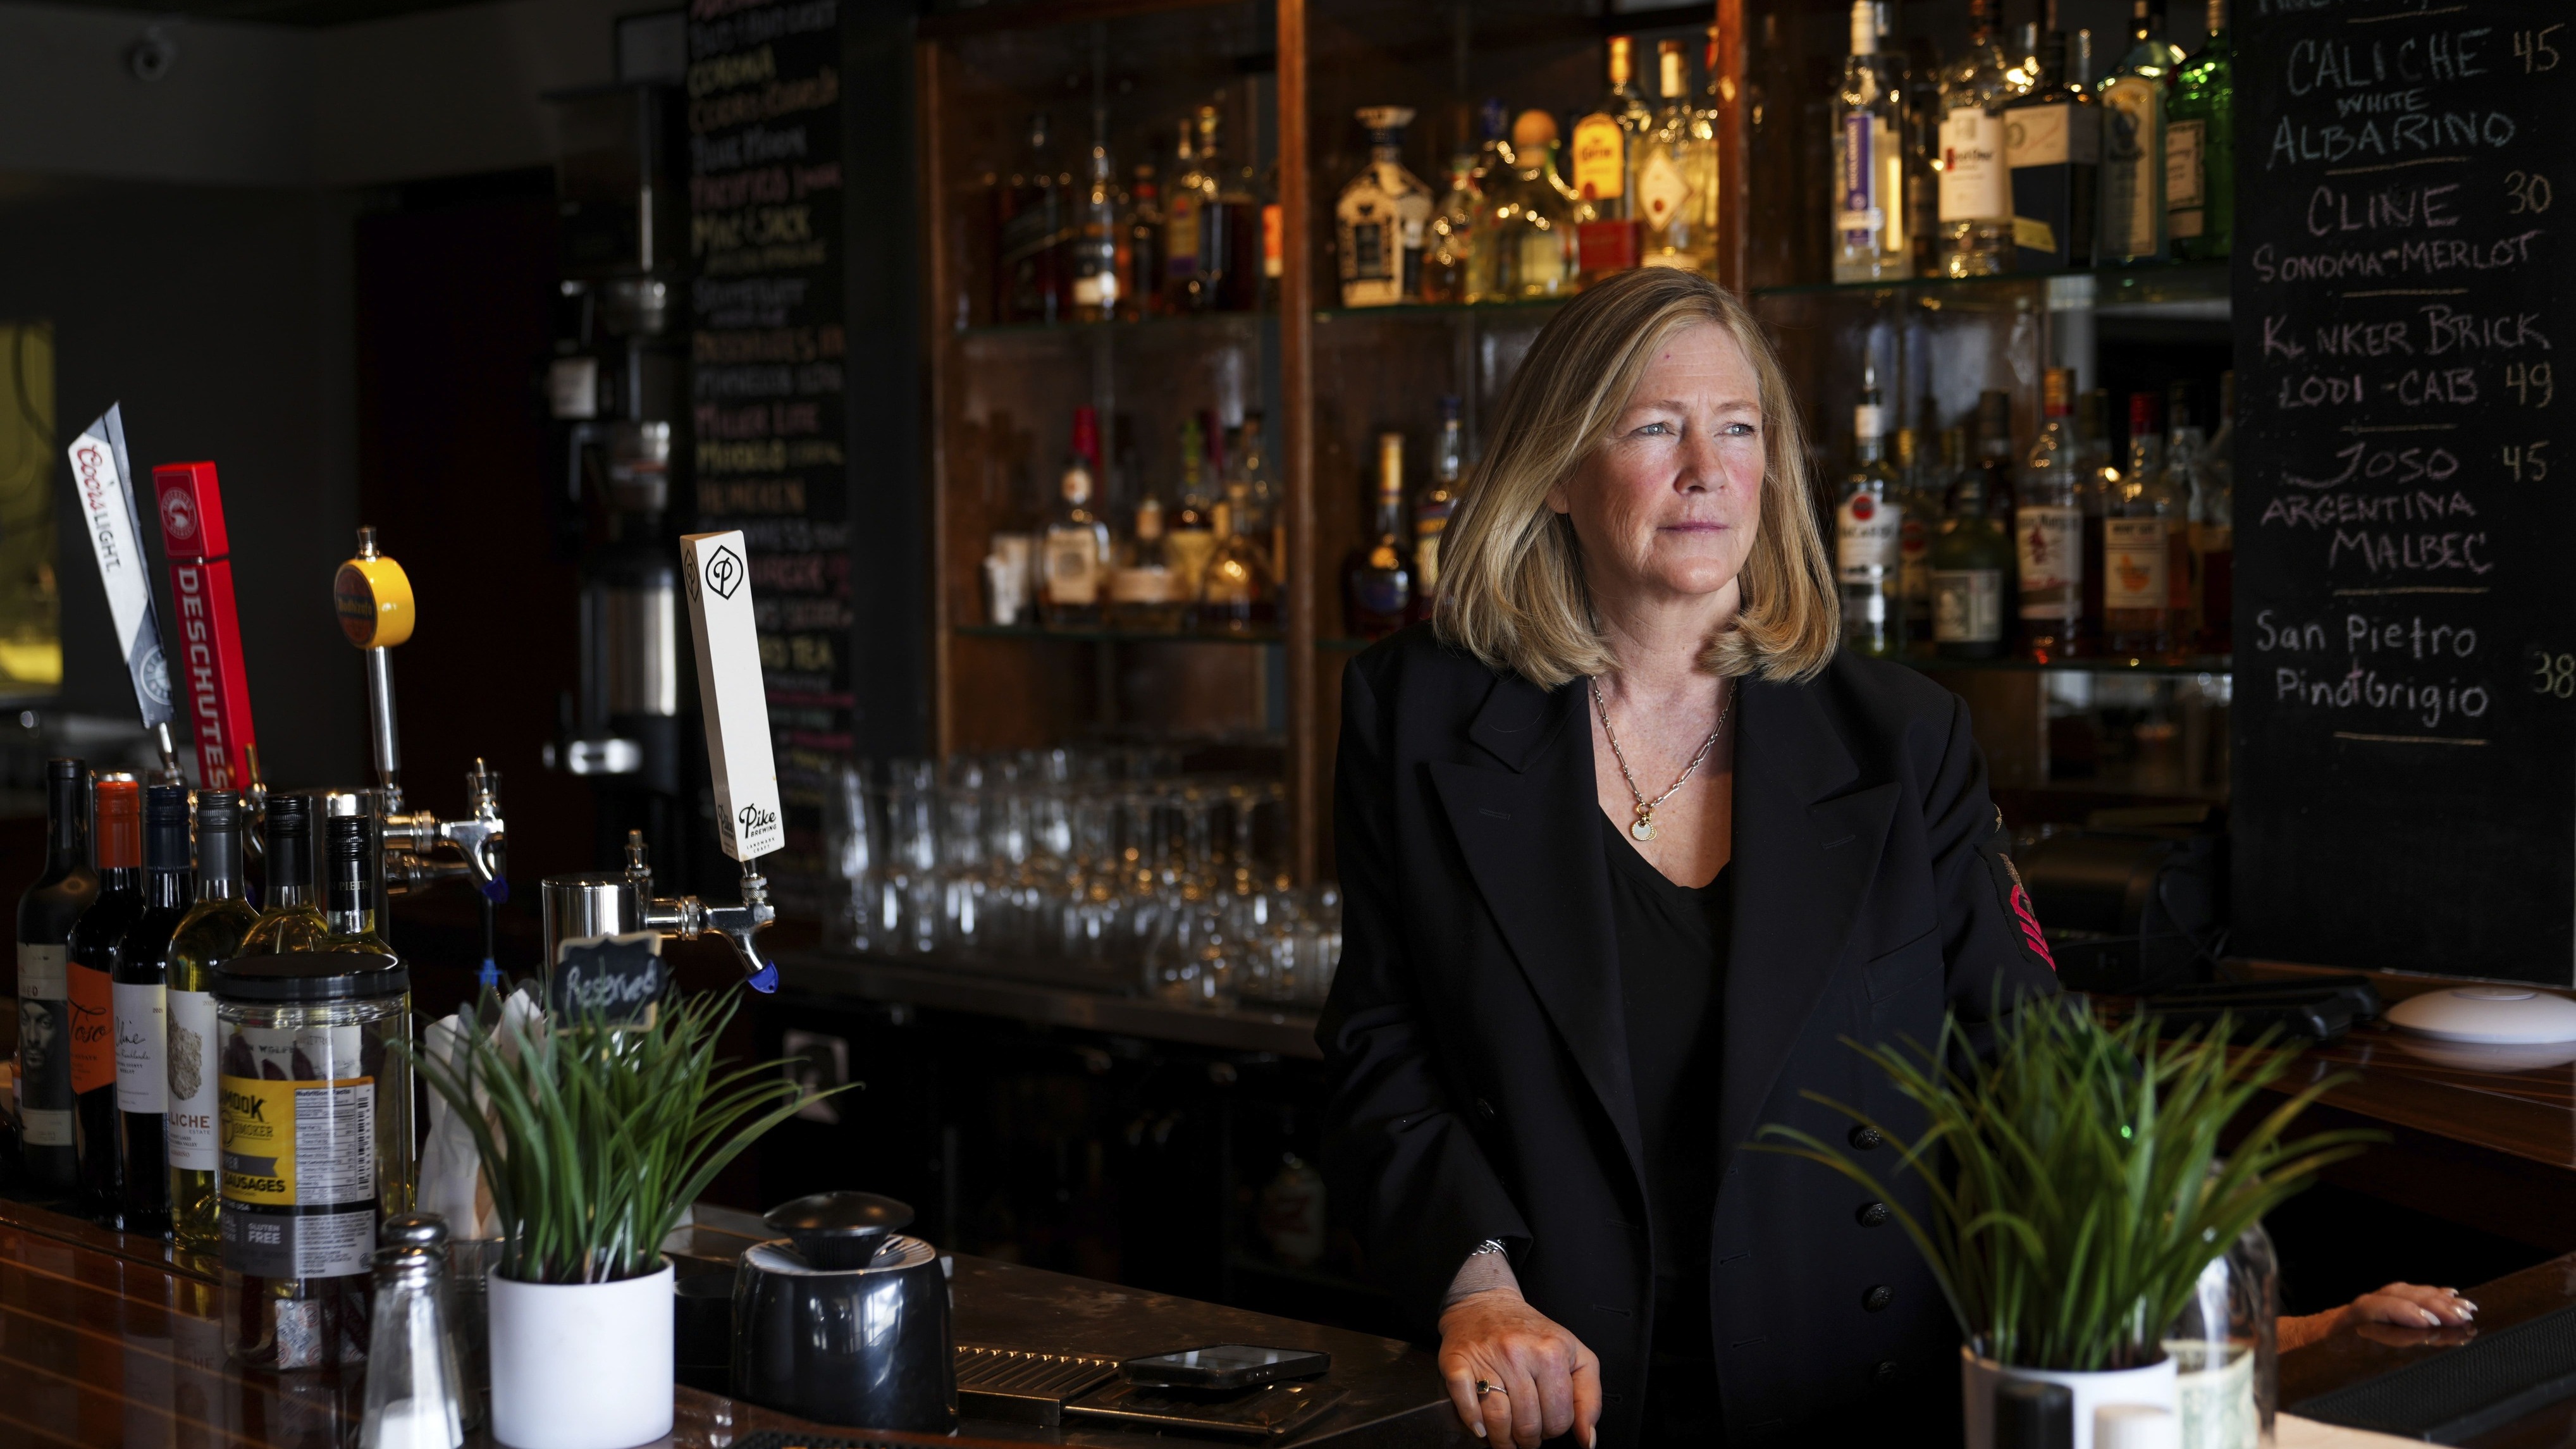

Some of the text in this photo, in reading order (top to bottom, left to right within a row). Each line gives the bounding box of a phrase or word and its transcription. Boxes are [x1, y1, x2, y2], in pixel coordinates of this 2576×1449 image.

[2288, 23, 2565, 96] CALICHE 45
[2336, 88, 2430, 116] WHITE
[2265, 111, 2516, 170] ALBARINO
[2307, 170, 2553, 236] CLINE 30
[2264, 304, 2552, 355] KLNKER BRICK
[2279, 375, 2363, 409] LODI
[2505, 361, 2553, 409] 49
[2502, 441, 2550, 483] 45
[2260, 490, 2477, 530] ARGENTINA
[94, 512, 121, 574] LIGHT
[2328, 527, 2494, 574] MALBEC
[2256, 609, 2477, 658] San Pietro
[178, 566, 229, 789] DESCHUTES
[2534, 651, 2576, 698] 38
[739, 803, 777, 839] Pike
[746, 837, 775, 849] LANDMARK
[751, 823, 777, 837] BREWING
[753, 844, 770, 853] CRAFT
[247, 1232, 281, 1245] FREE
[248, 1222, 281, 1232] GLUTEN
